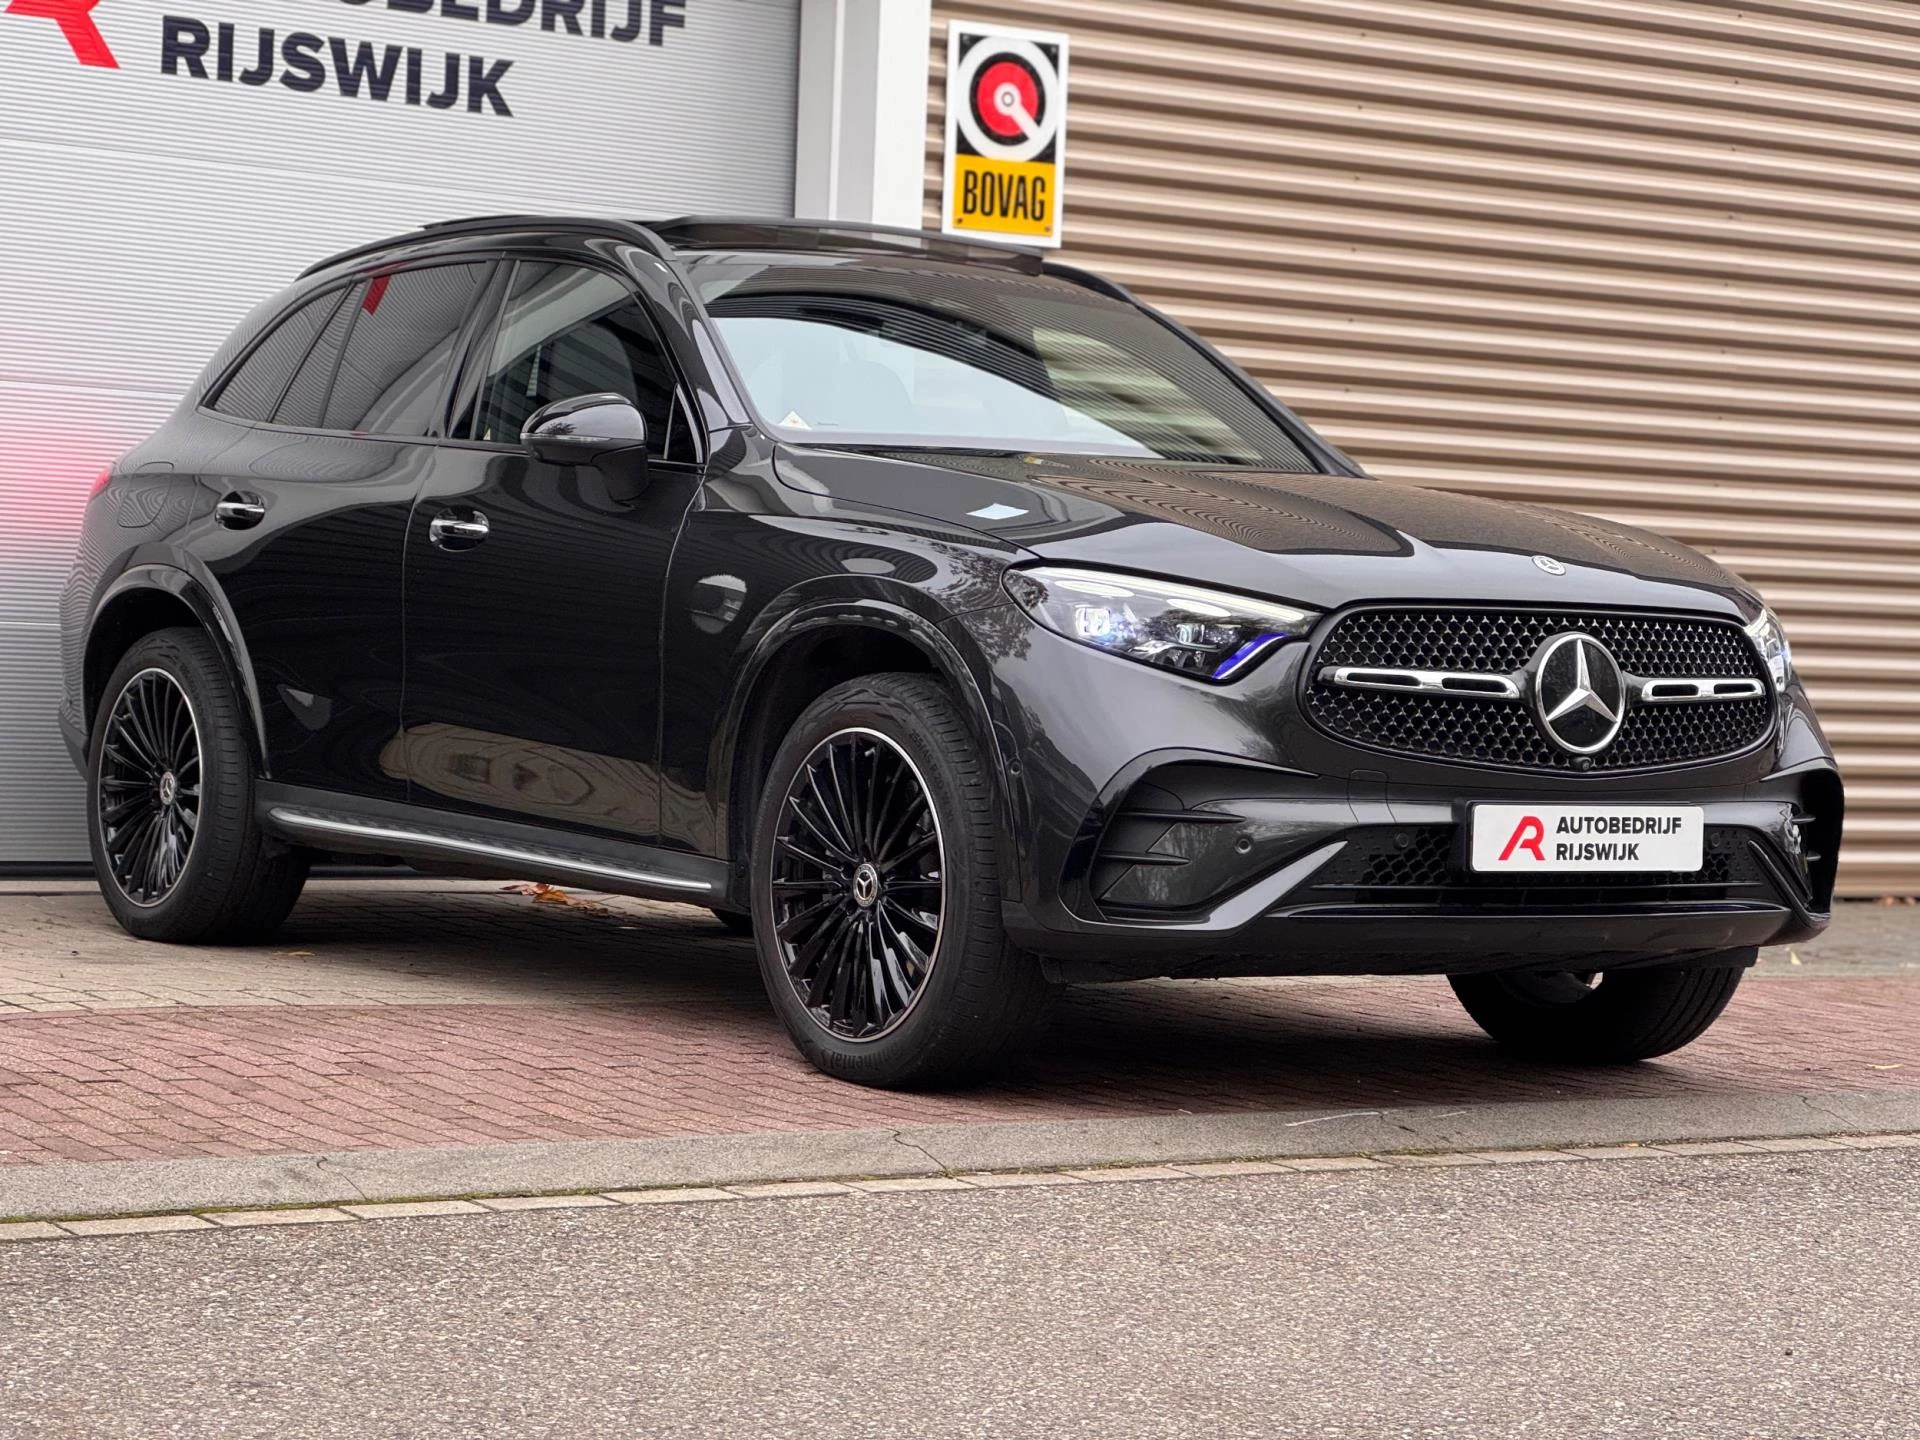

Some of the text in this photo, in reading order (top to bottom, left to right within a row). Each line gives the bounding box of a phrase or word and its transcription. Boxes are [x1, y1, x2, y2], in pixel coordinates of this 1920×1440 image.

[161, 15, 515, 117] RIJSWIJK
[962, 169, 1046, 221] BOVAG
[1556, 816, 1682, 834] AUTOBEDRIJF
[1556, 843, 1640, 861] RIJSWIJK
